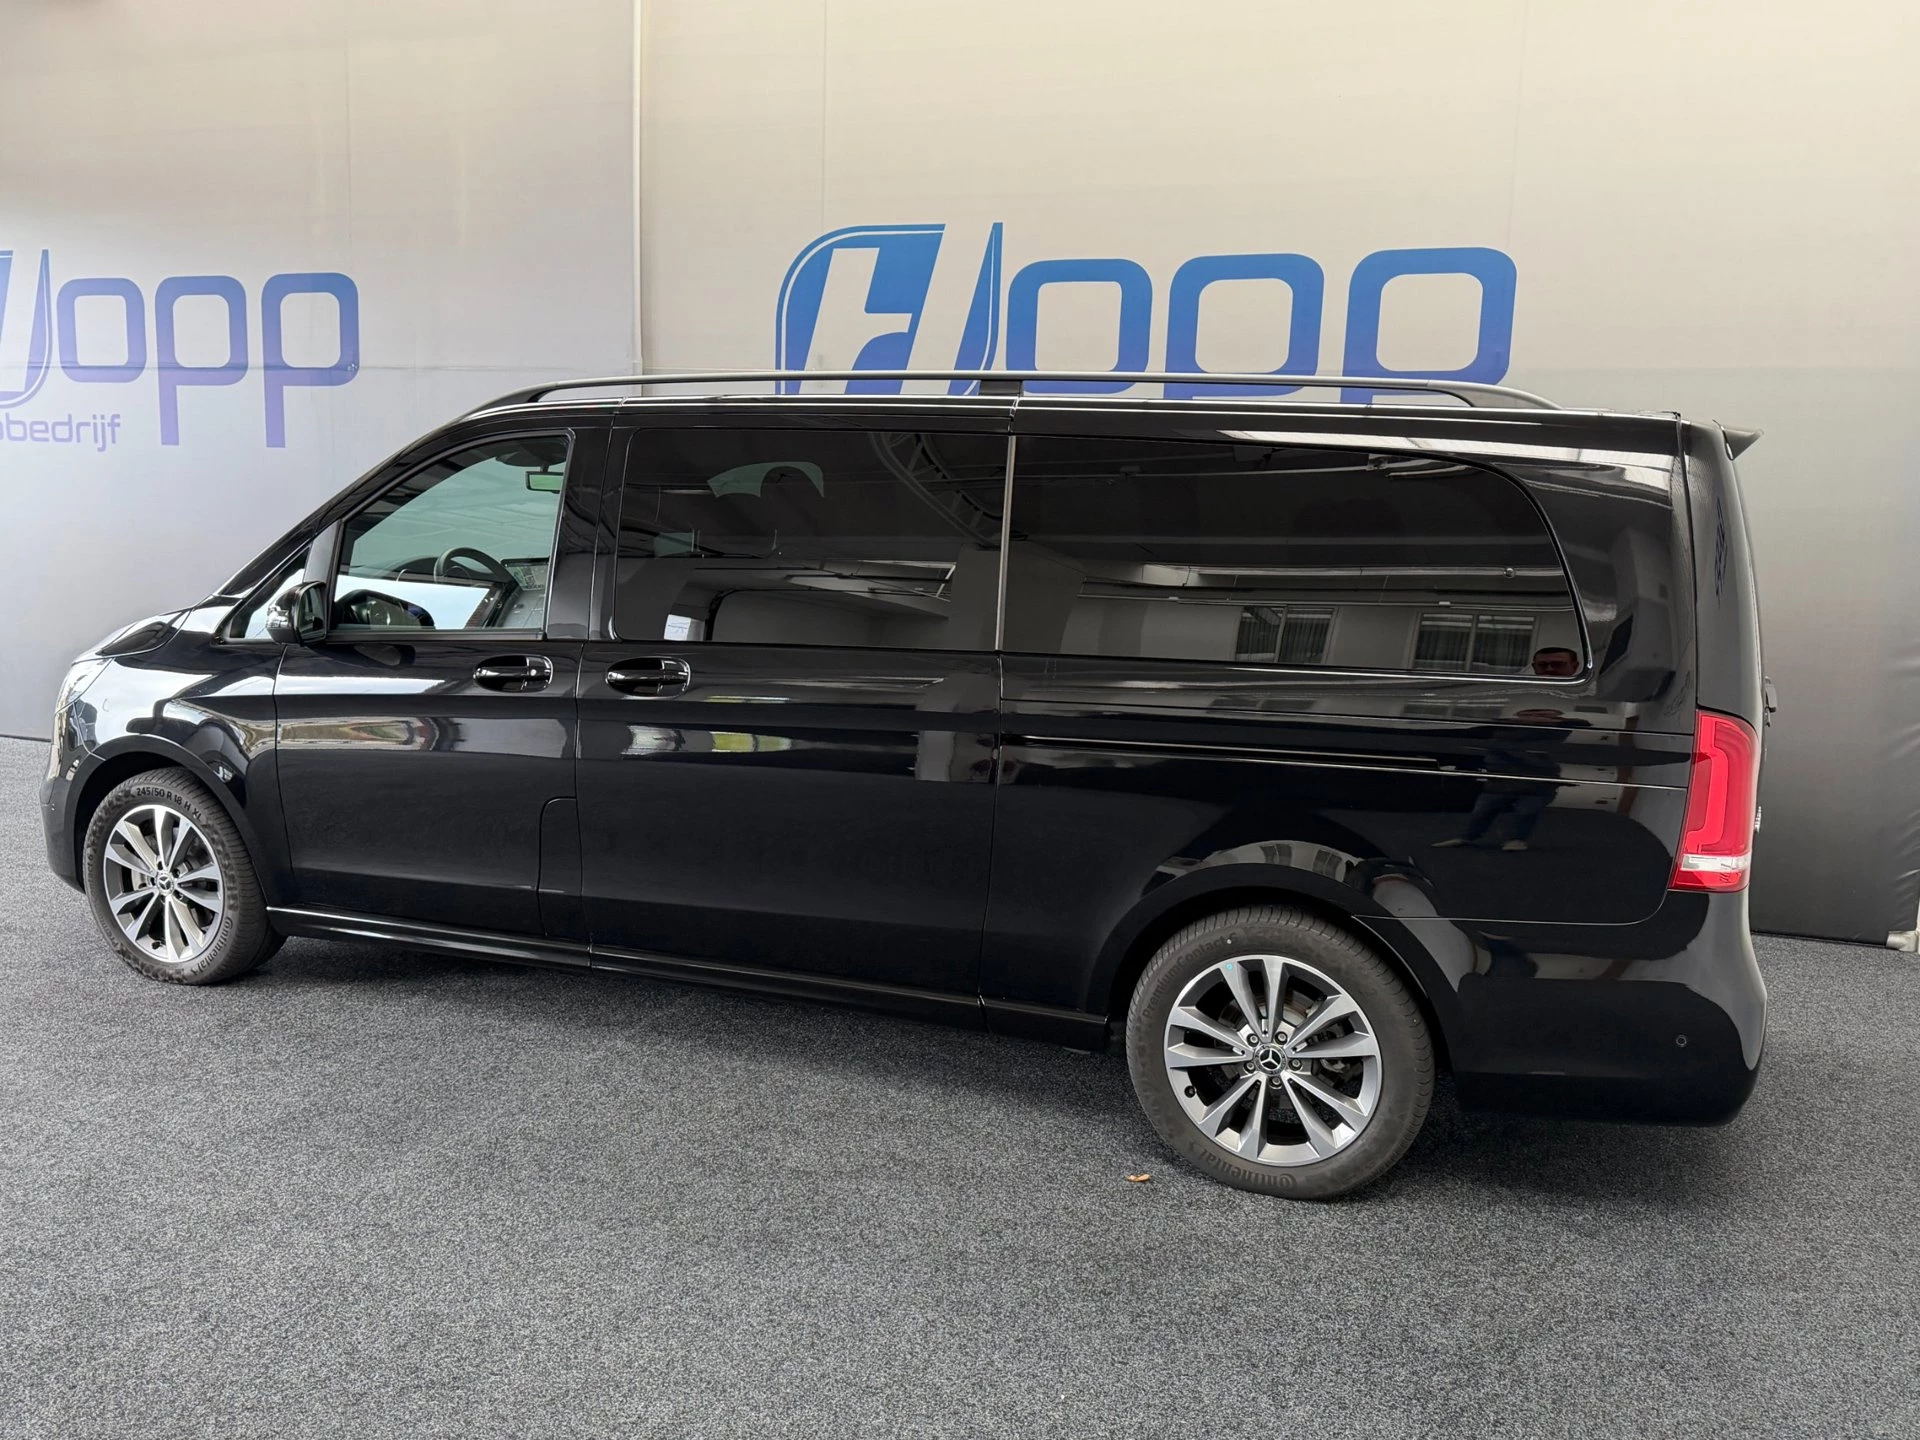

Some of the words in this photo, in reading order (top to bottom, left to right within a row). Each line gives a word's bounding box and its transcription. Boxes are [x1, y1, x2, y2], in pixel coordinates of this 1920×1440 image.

[0, 412, 121, 453] bedrijf
[136, 787, 165, 797] 245/50
[166, 791, 172, 800] R
[174, 794, 183, 805] 18
[184, 801, 191, 811] H
[192, 808, 202, 820] XL
[199, 916, 233, 973] Continental
[1200, 1148, 1297, 1189] Continental
